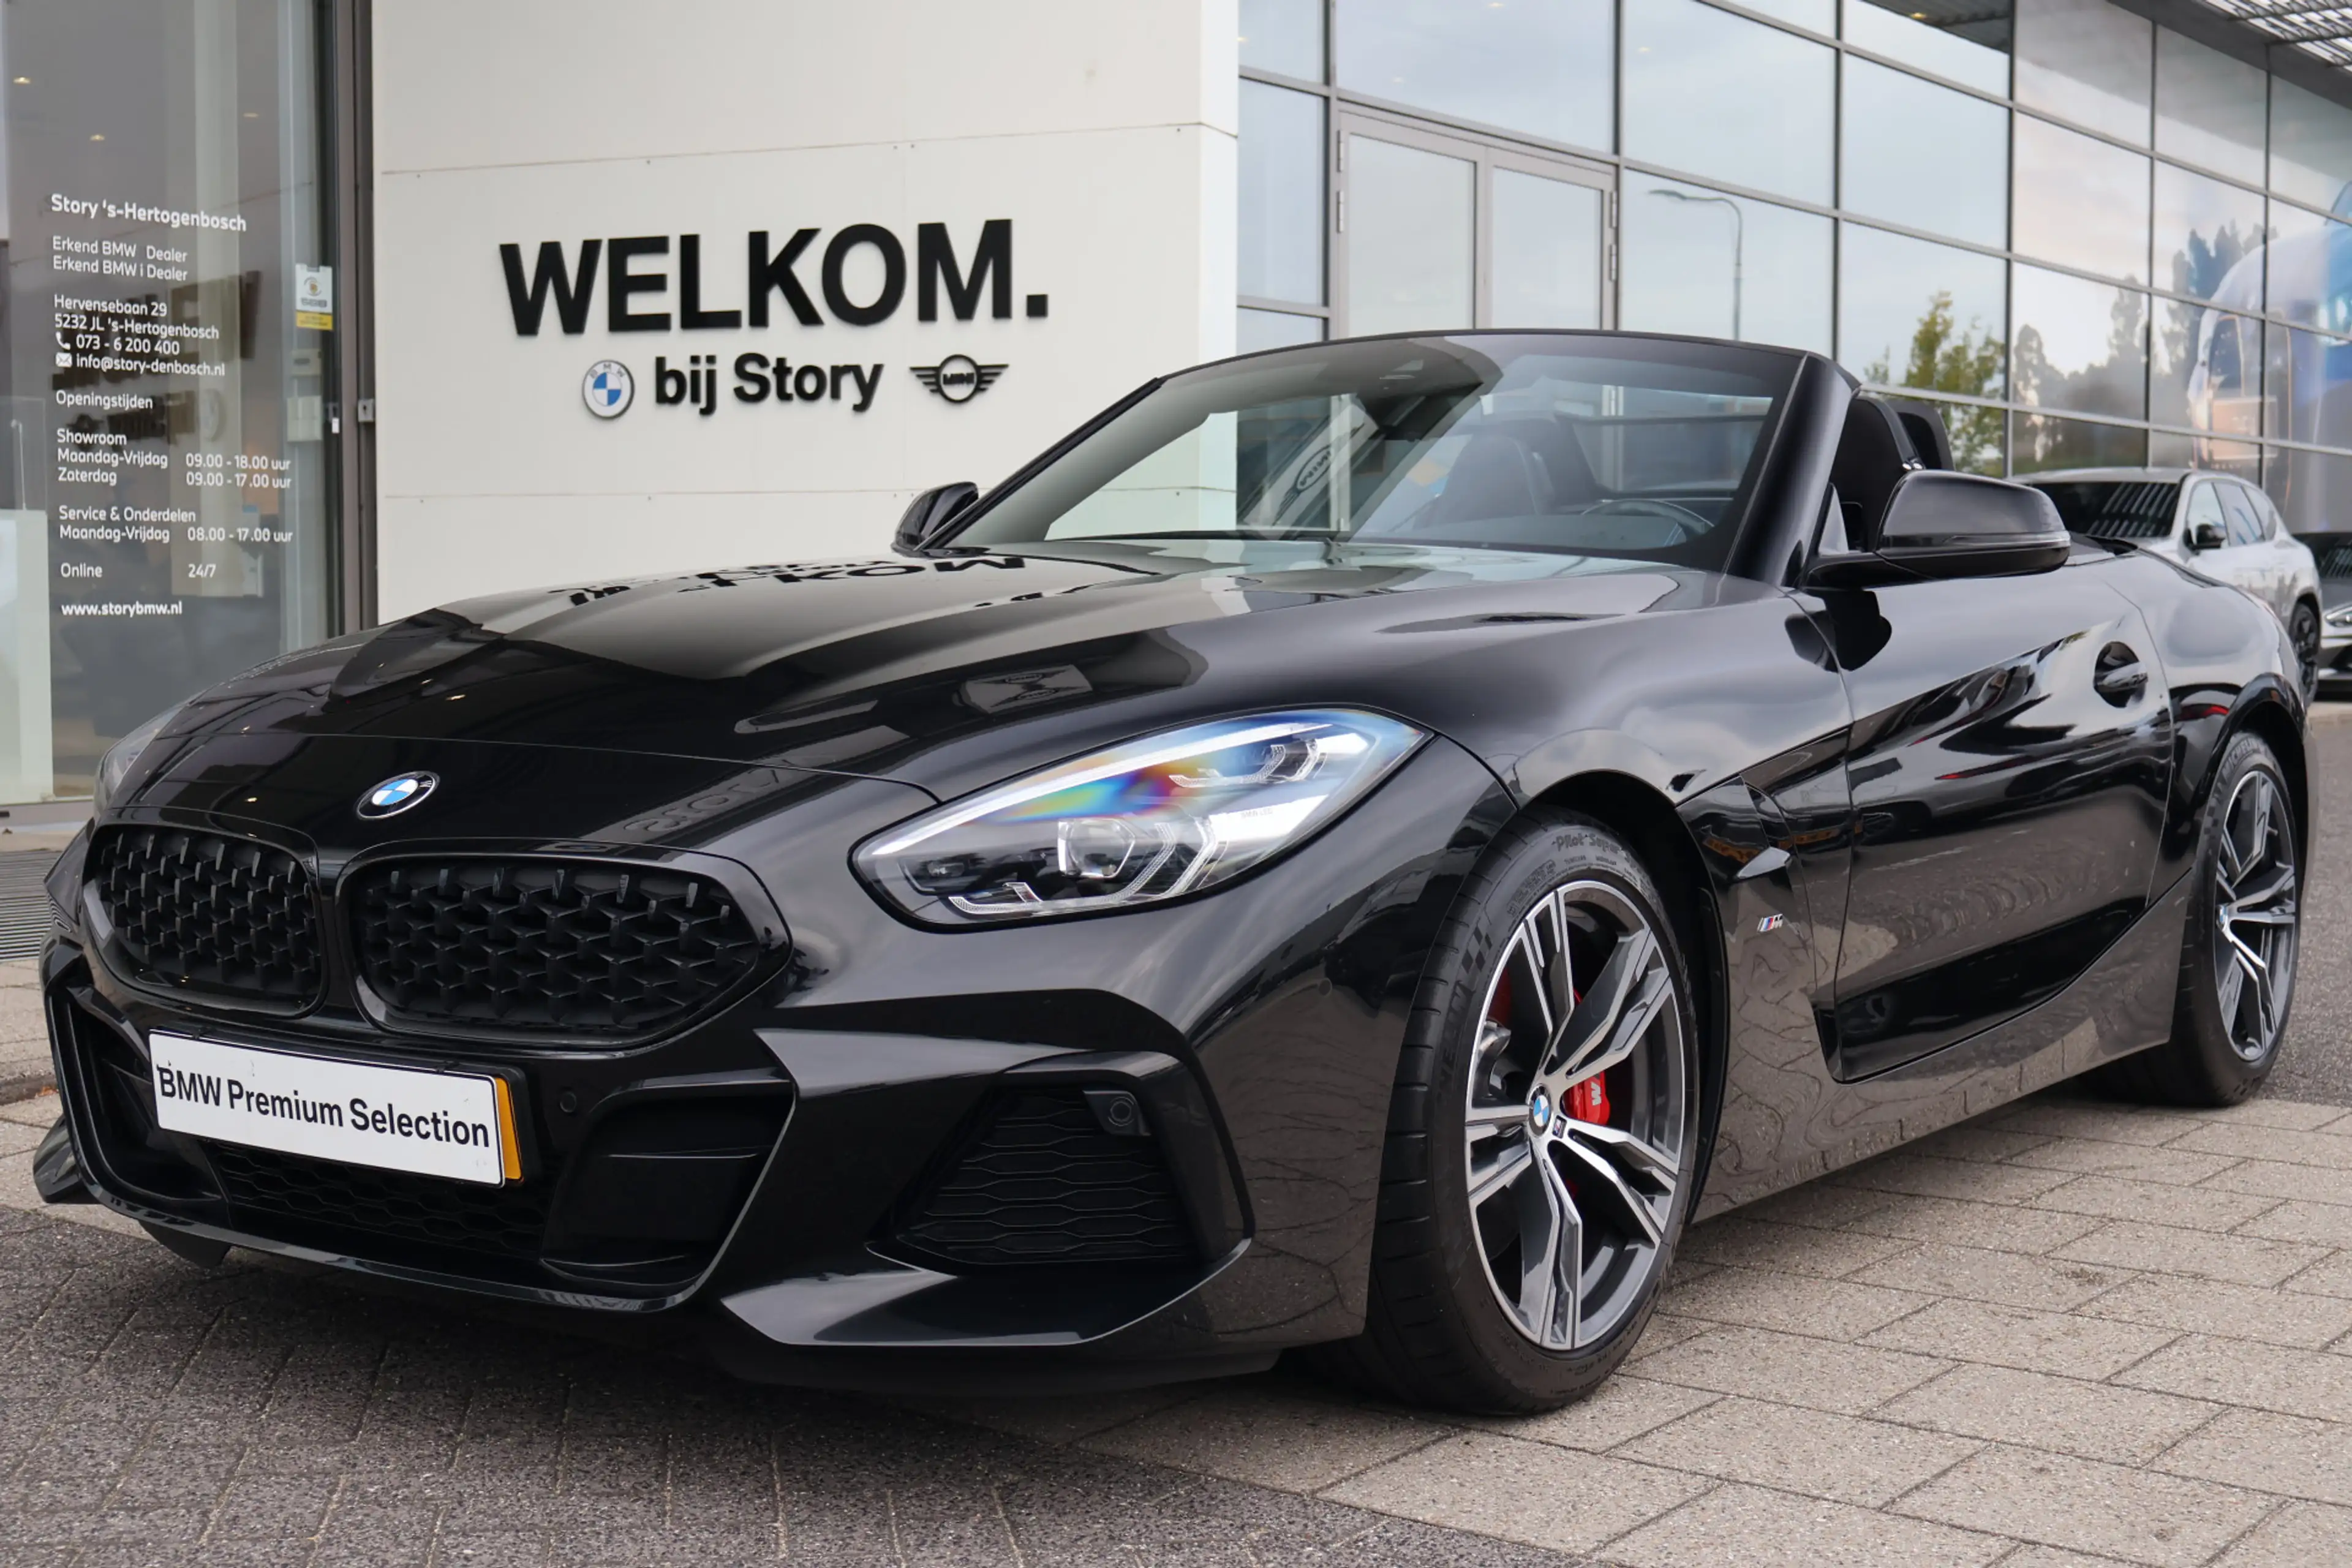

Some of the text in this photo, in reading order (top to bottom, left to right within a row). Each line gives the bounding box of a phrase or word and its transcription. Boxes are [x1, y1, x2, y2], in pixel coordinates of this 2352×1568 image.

[51, 194, 246, 232] Story 's-Hertogenbosch
[53, 235, 187, 263] Erkend BMW Dealer
[53, 255, 187, 281] Erkend BMW i Dealer
[499, 219, 1048, 336] WELKOM.
[54, 294, 167, 317] Hervensebaan 29
[55, 313, 219, 339] 5232 JL 's-Hertogenbosch
[76, 334, 100, 350] 073
[113, 337, 122, 352] 6
[125, 338, 151, 353] 200
[154, 340, 180, 355] 400
[76, 353, 225, 376] info@story-denbosch.nl
[655, 352, 884, 417] bij Story
[56, 390, 153, 411] Openingstijden
[57, 428, 127, 445] Showroom
[58, 448, 168, 469] Maandag-Vrijdag
[186, 453, 223, 467] 09.00
[234, 455, 268, 470] 18.00
[271, 459, 290, 470] uur
[58, 467, 117, 486] Zaterdag
[186, 472, 223, 487] 09.00
[272, 477, 292, 489] uur
[59, 505, 196, 522] Service & Onderdelen
[60, 524, 170, 543] Maandag-Vrijdag
[187, 527, 225, 541] 08.00
[274, 531, 293, 543] uur
[61, 562, 216, 578] Online 24/7
[61, 601, 183, 617] www.storybmw.nl
[157, 1067, 489, 1148] BMW Premium Selection
